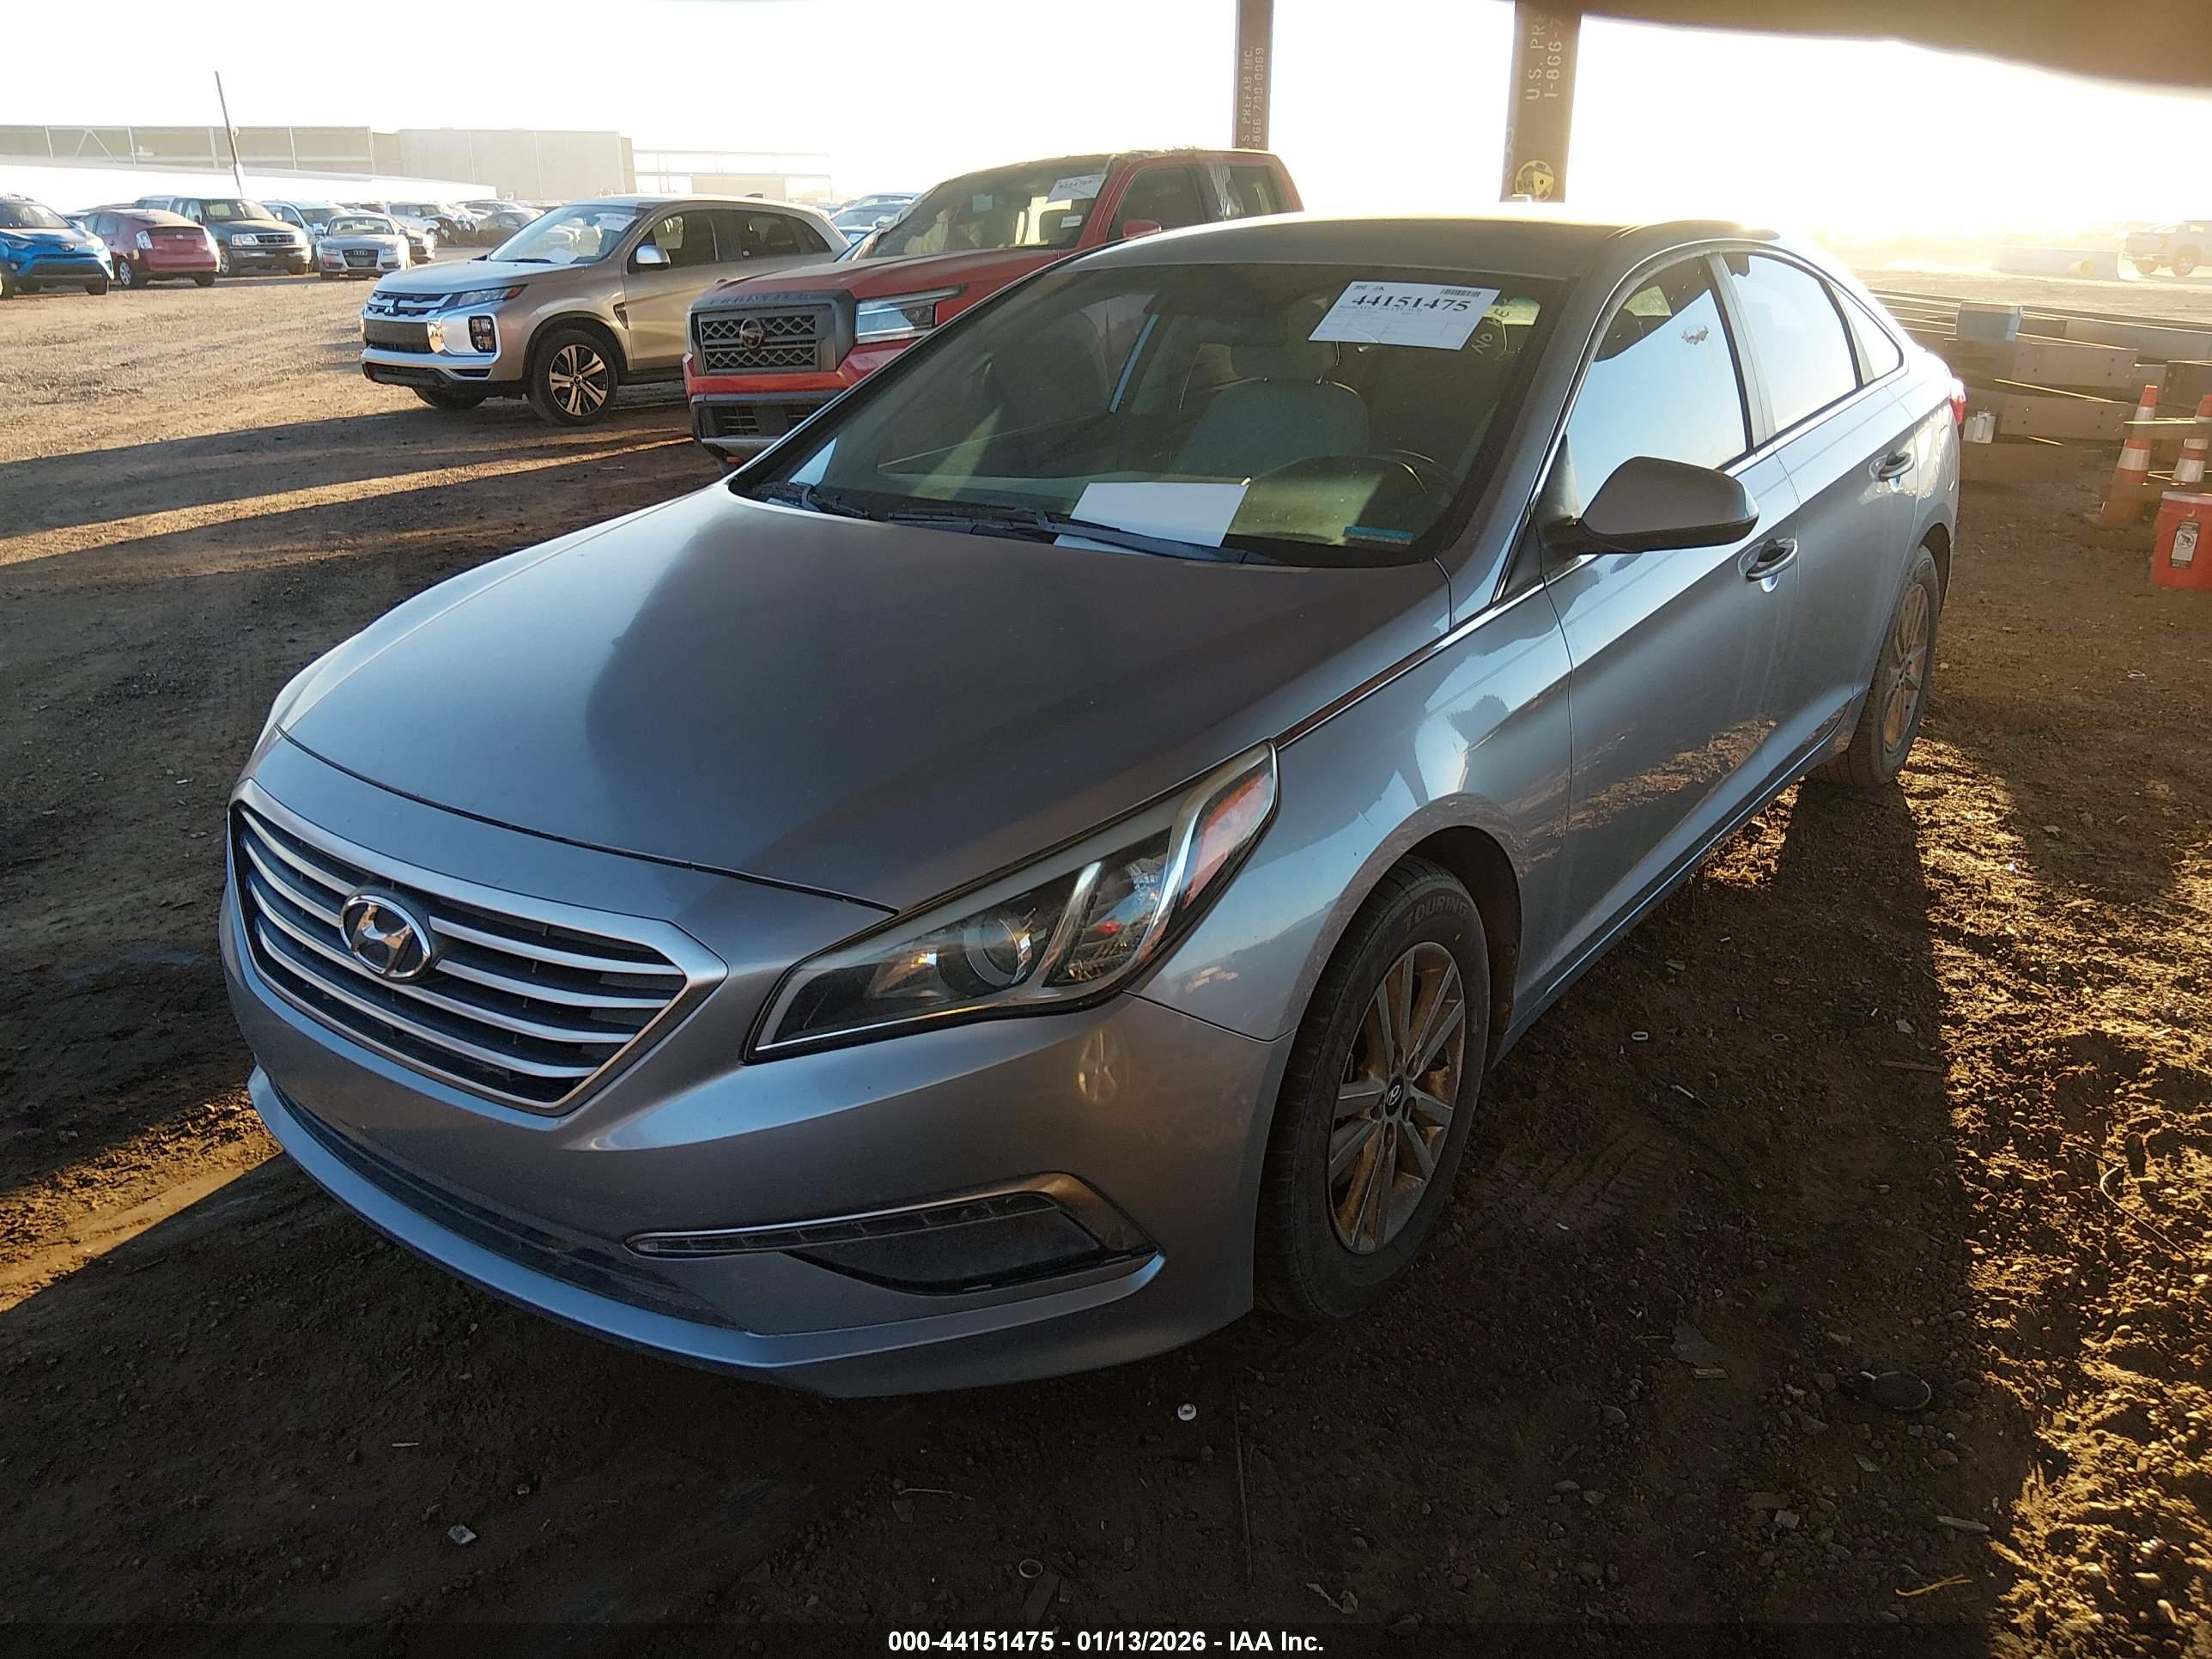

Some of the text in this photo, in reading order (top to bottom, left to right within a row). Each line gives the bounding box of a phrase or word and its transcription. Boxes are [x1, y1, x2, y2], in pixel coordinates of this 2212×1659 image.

[1242, 76, 1252, 125] PREFAB
[1252, 47, 1264, 148] -866-799-0969
[1352, 295, 1472, 312] 44151475
[1471, 333, 1493, 355] NO
